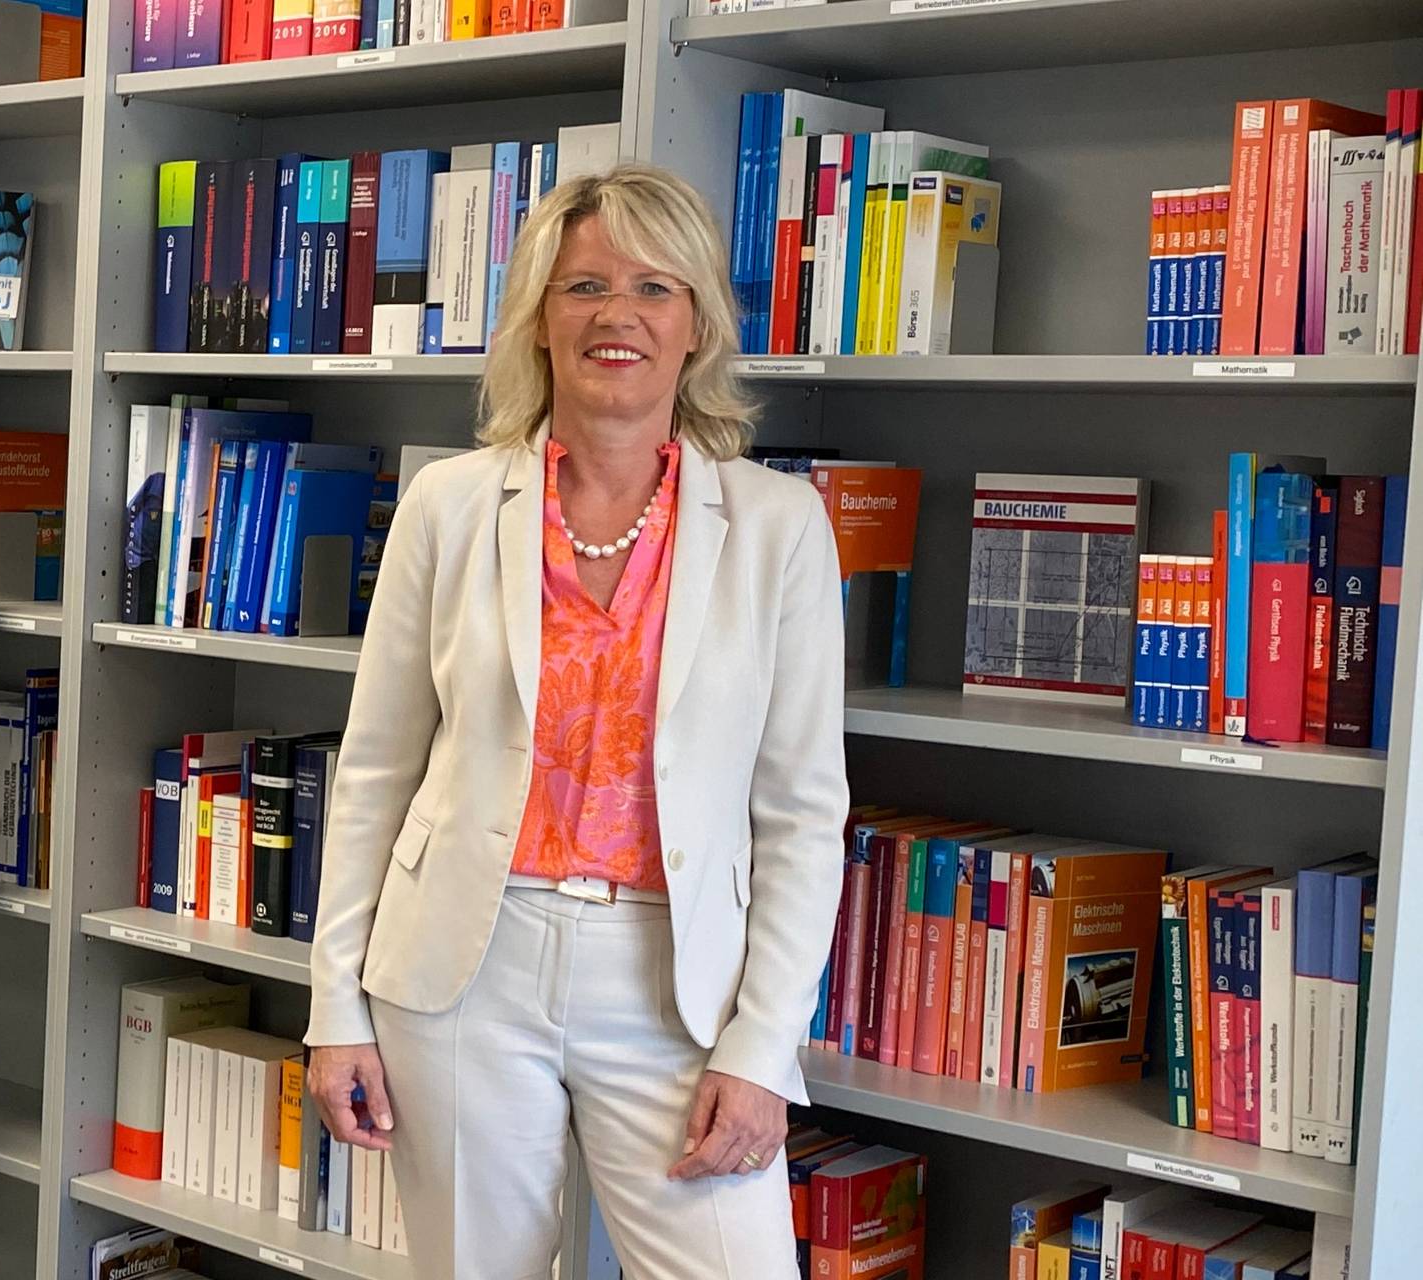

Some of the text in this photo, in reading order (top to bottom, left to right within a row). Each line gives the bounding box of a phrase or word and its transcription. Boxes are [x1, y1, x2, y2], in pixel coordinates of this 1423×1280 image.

[275, 25, 304, 39] 2013
[314, 22, 346, 38] 2016
[1248, 145, 1261, 197] Mathematik
[1287, 133, 1299, 185] Mathematik
[1244, 214, 1255, 260] Ingenieure
[1283, 202, 1295, 249] Ingenieure
[1340, 200, 1354, 273] Taschenbuch
[1358, 180, 1373, 273] der Mathematik
[1243, 262, 1253, 279] und
[1281, 251, 1290, 267] und
[1152, 264, 1161, 312] Mathematik
[1168, 263, 1178, 311] Mathematik
[1183, 263, 1192, 311] Mathematik
[1197, 260, 1207, 309] Mathematik
[1212, 260, 1222, 309] Mathematik
[907, 289, 920, 338] Börse 365
[748, 363, 805, 372] Rechnungswesen
[1221, 365, 1268, 375] Mathematik
[841, 491, 898, 510] Bauchemie
[984, 502, 1067, 519] BAUCHEMIE
[1140, 628, 1150, 655] Physik
[1159, 629, 1169, 656] Physik
[1177, 631, 1188, 658] Physik
[1196, 631, 1207, 659] Physik
[1267, 598, 1282, 662] Gerthsen Physik
[1312, 605, 1326, 669] Fluidmechanik
[1337, 606, 1353, 681] Fluidmechanik
[1353, 606, 1370, 661] Technische
[1210, 753, 1236, 765] Physik
[156, 783, 178, 796] VOB
[265, 815, 276, 823] VOB
[153, 882, 173, 896] 2009
[1074, 901, 1125, 919] Elektrische
[1073, 921, 1122, 937] Maschinen
[951, 923, 967, 1014] Robotik mit MATLAB
[1028, 905, 1047, 1029] Elektrische Maschinen
[1169, 925, 1182, 984] Elektrotechnik
[1192, 929, 1201, 978] Elektrotechnik
[925, 951, 937, 1007] Handbuch Robotik
[1172, 986, 1182, 1000] der
[127, 1015, 152, 1033] BGB
[1195, 992, 1203, 1031] Werkstoffe
[1219, 1001, 1230, 1050] Werkstoffe
[1173, 1012, 1185, 1057] Werkstoffe
[1270, 1023, 1278, 1084] Werkstoffkunde
[1154, 1161, 1215, 1182] Werkstoffkunde
[852, 1244, 917, 1273] Maschinenelemente
